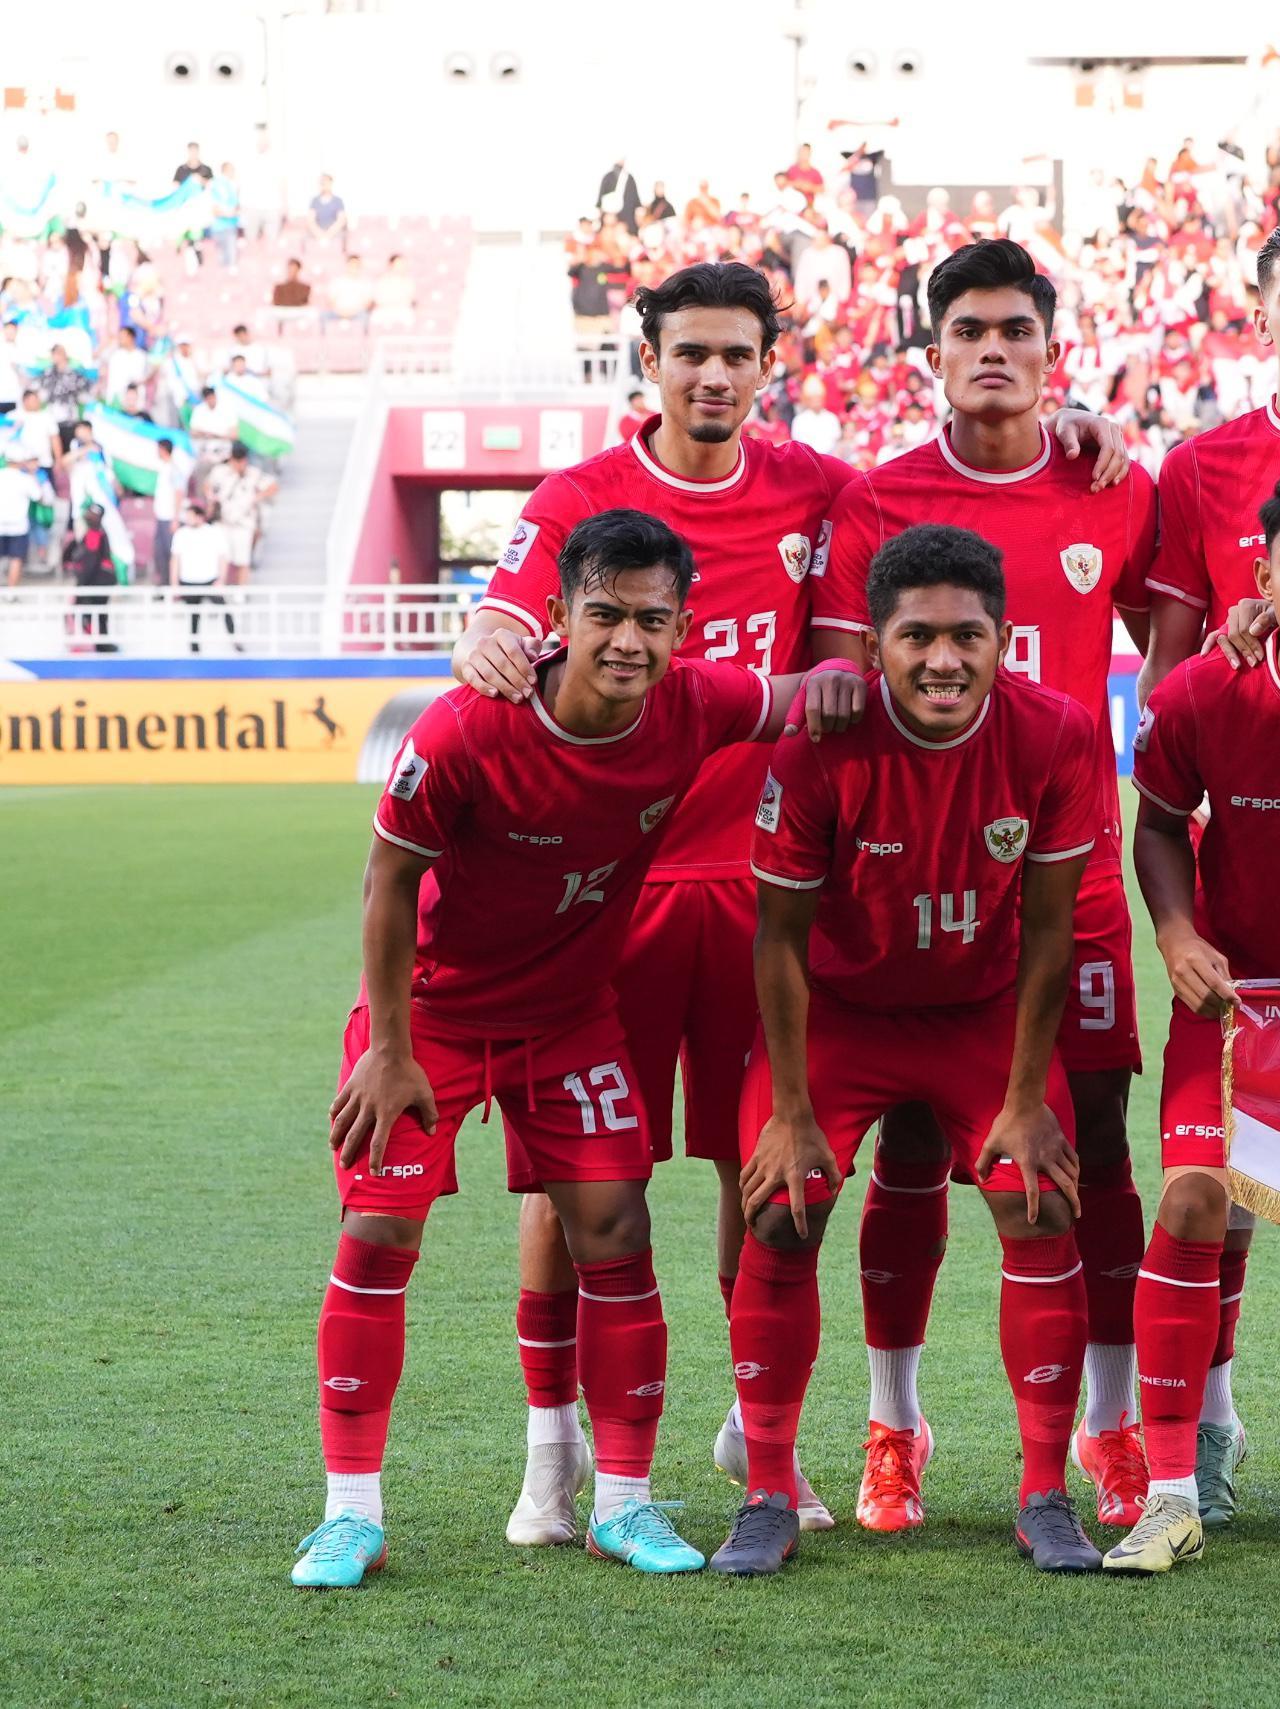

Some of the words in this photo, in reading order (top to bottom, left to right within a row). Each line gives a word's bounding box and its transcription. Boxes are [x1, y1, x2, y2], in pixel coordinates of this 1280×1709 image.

[430, 430, 459, 450] 22
[549, 430, 575, 450] 21
[1239, 533, 1267, 548] ers
[703, 610, 777, 677] 23
[0, 699, 288, 752] ntinental
[508, 831, 563, 846] erspo
[856, 837, 903, 856] erspo
[555, 860, 617, 915] 12
[913, 889, 981, 949] 14
[1079, 960, 1115, 1030] 9
[563, 1061, 638, 1134] 12
[1175, 1125, 1226, 1139] erspo
[380, 1164, 424, 1179] rspo
[1139, 1374, 1187, 1387] ONESIA
